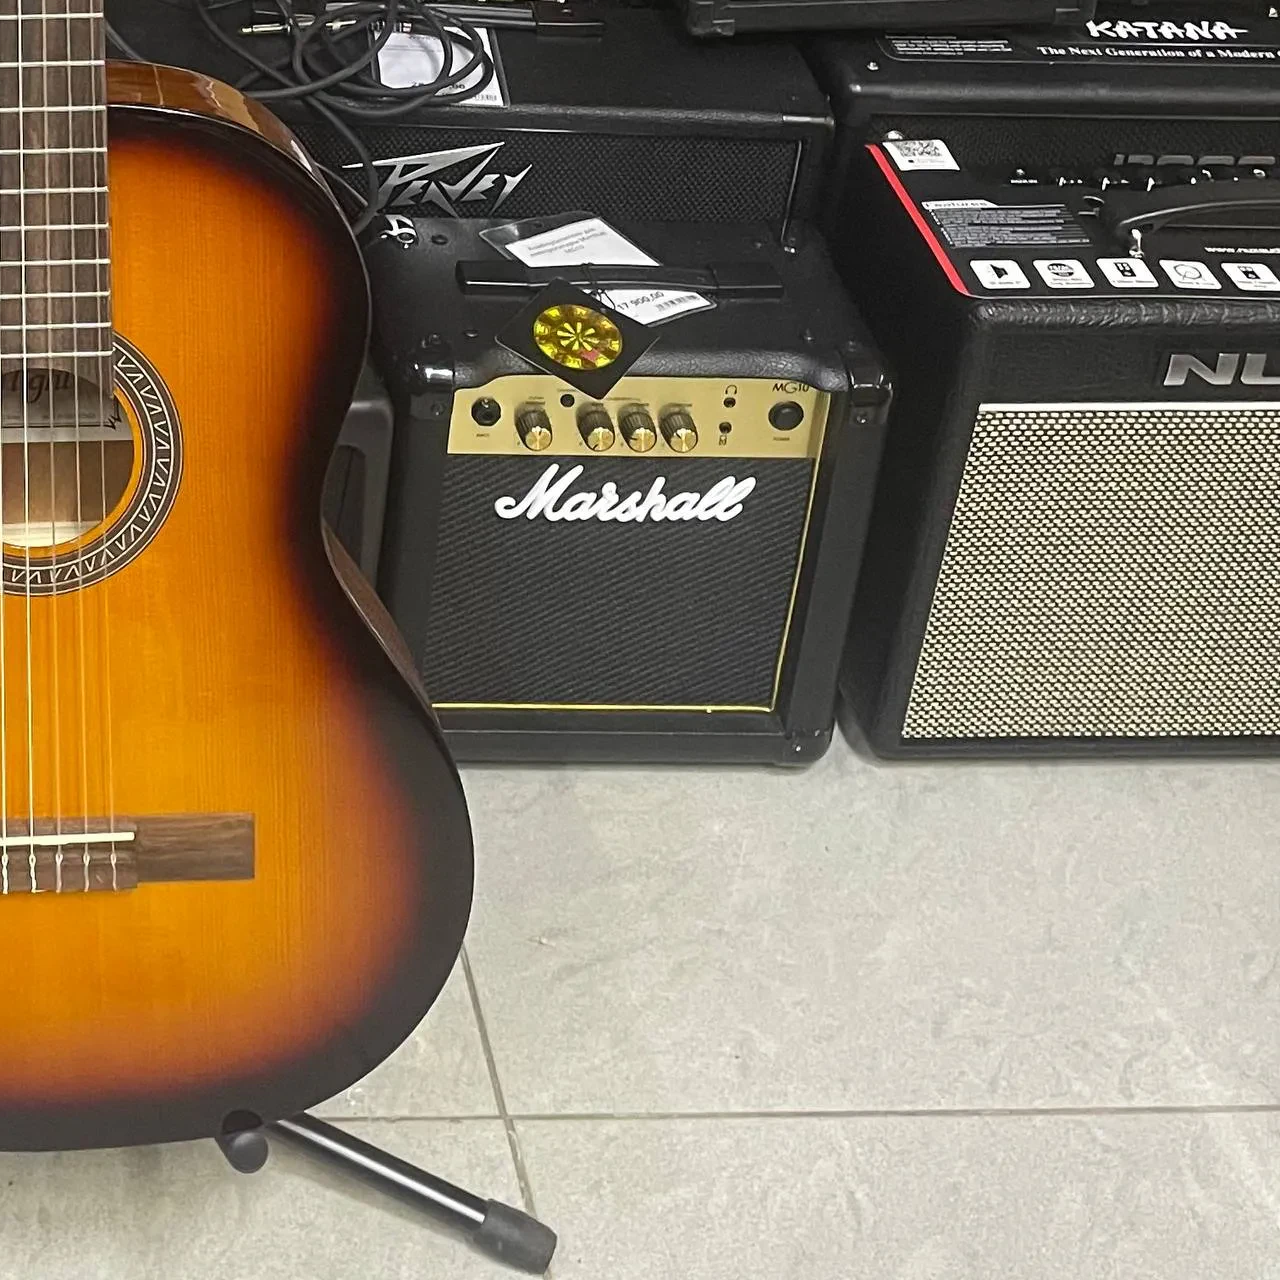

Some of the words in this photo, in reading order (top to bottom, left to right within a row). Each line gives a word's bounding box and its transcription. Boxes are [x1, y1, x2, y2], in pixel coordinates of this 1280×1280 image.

[1085, 20, 1249, 40] KATANA
[1037, 46, 1066, 56] The
[1068, 46, 1103, 56] Next
[1105, 47, 1185, 58] Generation
[1188, 48, 1202, 58] of
[1205, 50, 1215, 58] a
[1217, 48, 1275, 59] Modern
[494, 463, 757, 522] Marshall
